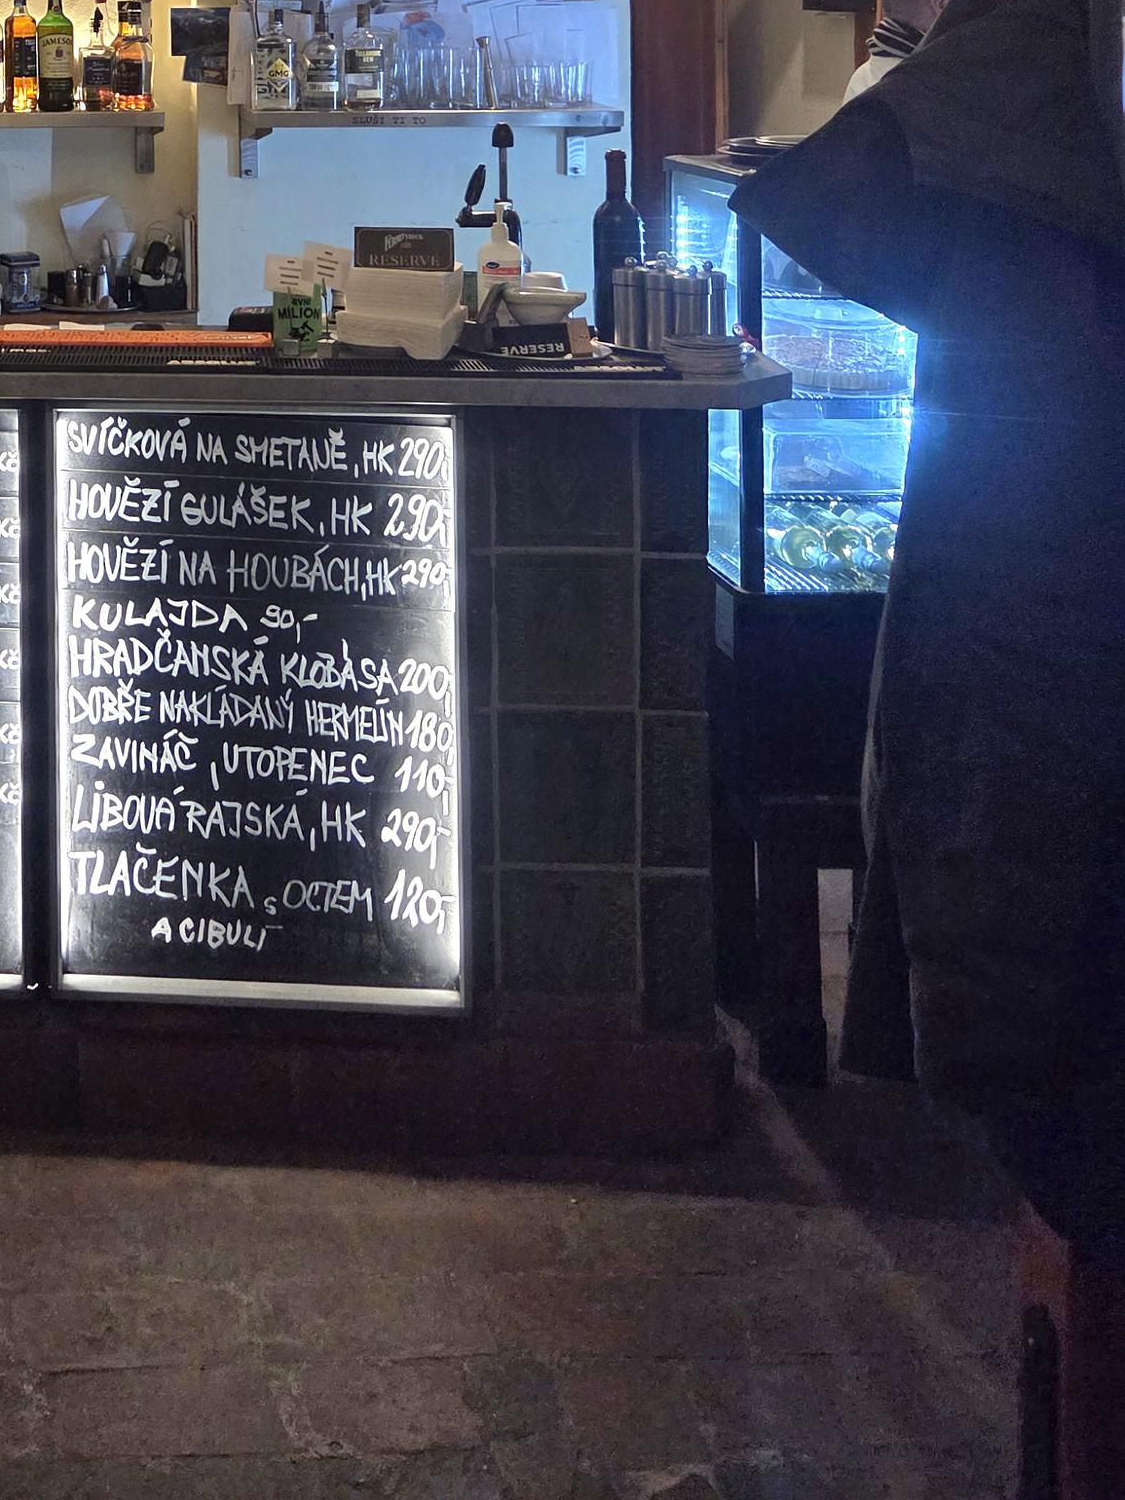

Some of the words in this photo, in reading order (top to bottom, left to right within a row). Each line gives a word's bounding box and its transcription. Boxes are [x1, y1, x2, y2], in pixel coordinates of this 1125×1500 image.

[42, 37, 73, 48] JAMESO
[411, 116, 427, 125] TO
[277, 307, 322, 320] MILION
[500, 342, 565, 357] RESERVE
[68, 417, 190, 464] SVÍČKOVÁ
[196, 432, 228, 465] NA
[363, 440, 395, 476] HK
[68, 476, 179, 523] HOVĚZÍ
[331, 498, 373, 536] HK
[68, 536, 174, 585] HOVĚZÍ
[179, 549, 216, 587] NA
[365, 558, 396, 596] HK
[72, 597, 249, 633] KULAJDA
[69, 627, 270, 685] HRADČANSKÁ
[280, 639, 399, 697] KLOBÁSA
[68, 678, 152, 726] DOBŘE
[159, 683, 294, 733] NAKLÁDANÝ
[223, 741, 375, 786] UTOPENEC
[320, 801, 367, 849] HK
[68, 841, 255, 910] TLAČENKA
[282, 879, 374, 922] OCTEM
[151, 916, 173, 943] A
